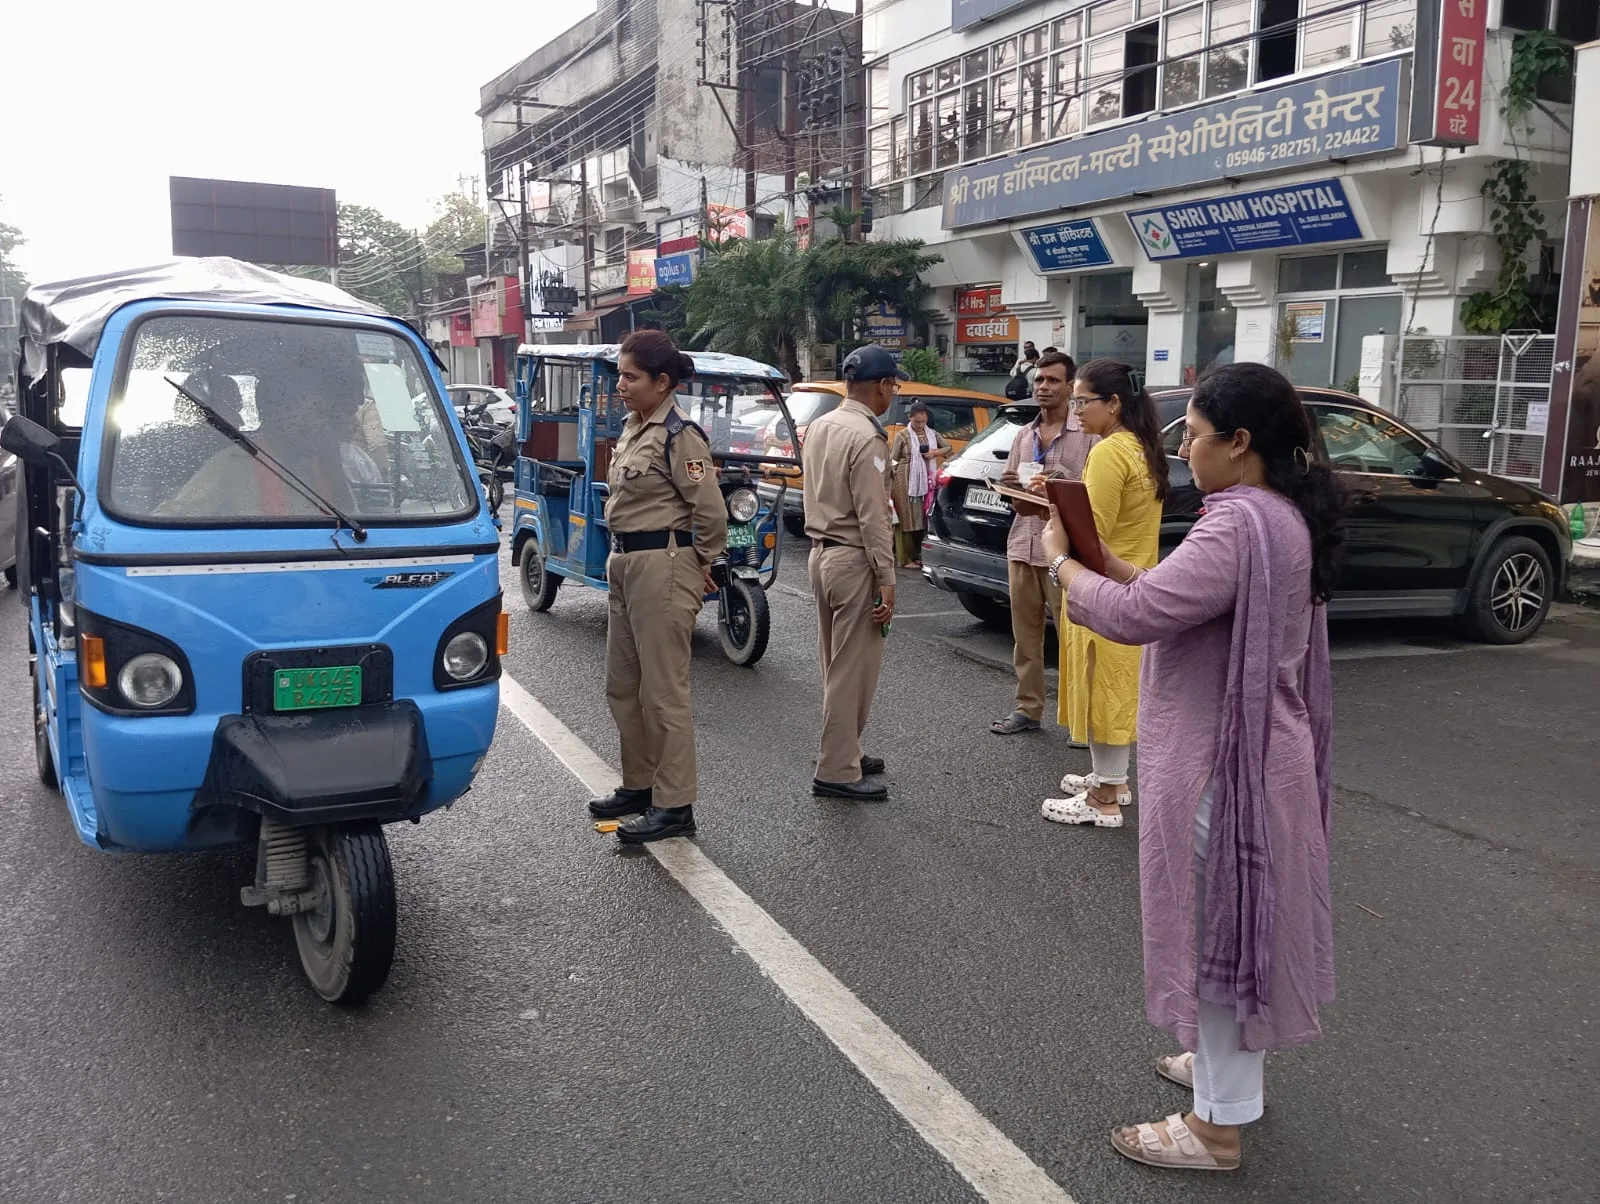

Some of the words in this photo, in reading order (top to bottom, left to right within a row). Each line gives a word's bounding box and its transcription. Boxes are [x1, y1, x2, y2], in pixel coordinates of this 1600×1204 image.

[1444, 77, 1475, 111] 24
[1449, 114, 1468, 135] घंटे
[950, 175, 969, 205] श्री
[972, 174, 1000, 200] राम
[1148, 97, 1296, 163] स्पेशीऐलिटी
[1303, 86, 1385, 131] सेन्टर
[1226, 138, 1321, 168] 05946-282751,
[1324, 125, 1380, 150] 224422
[1166, 206, 1209, 230] SHRI
[1206, 200, 1246, 224] RAM
[1247, 185, 1344, 218] HOSPITAL
[1029, 231, 1041, 246] श्री
[1040, 233, 1057, 245] राम
[970, 296, 985, 309] Hrs.
[965, 318, 1009, 338] दवाईयाँ
[294, 668, 354, 688] UK04E
[293, 687, 354, 706] R4275
